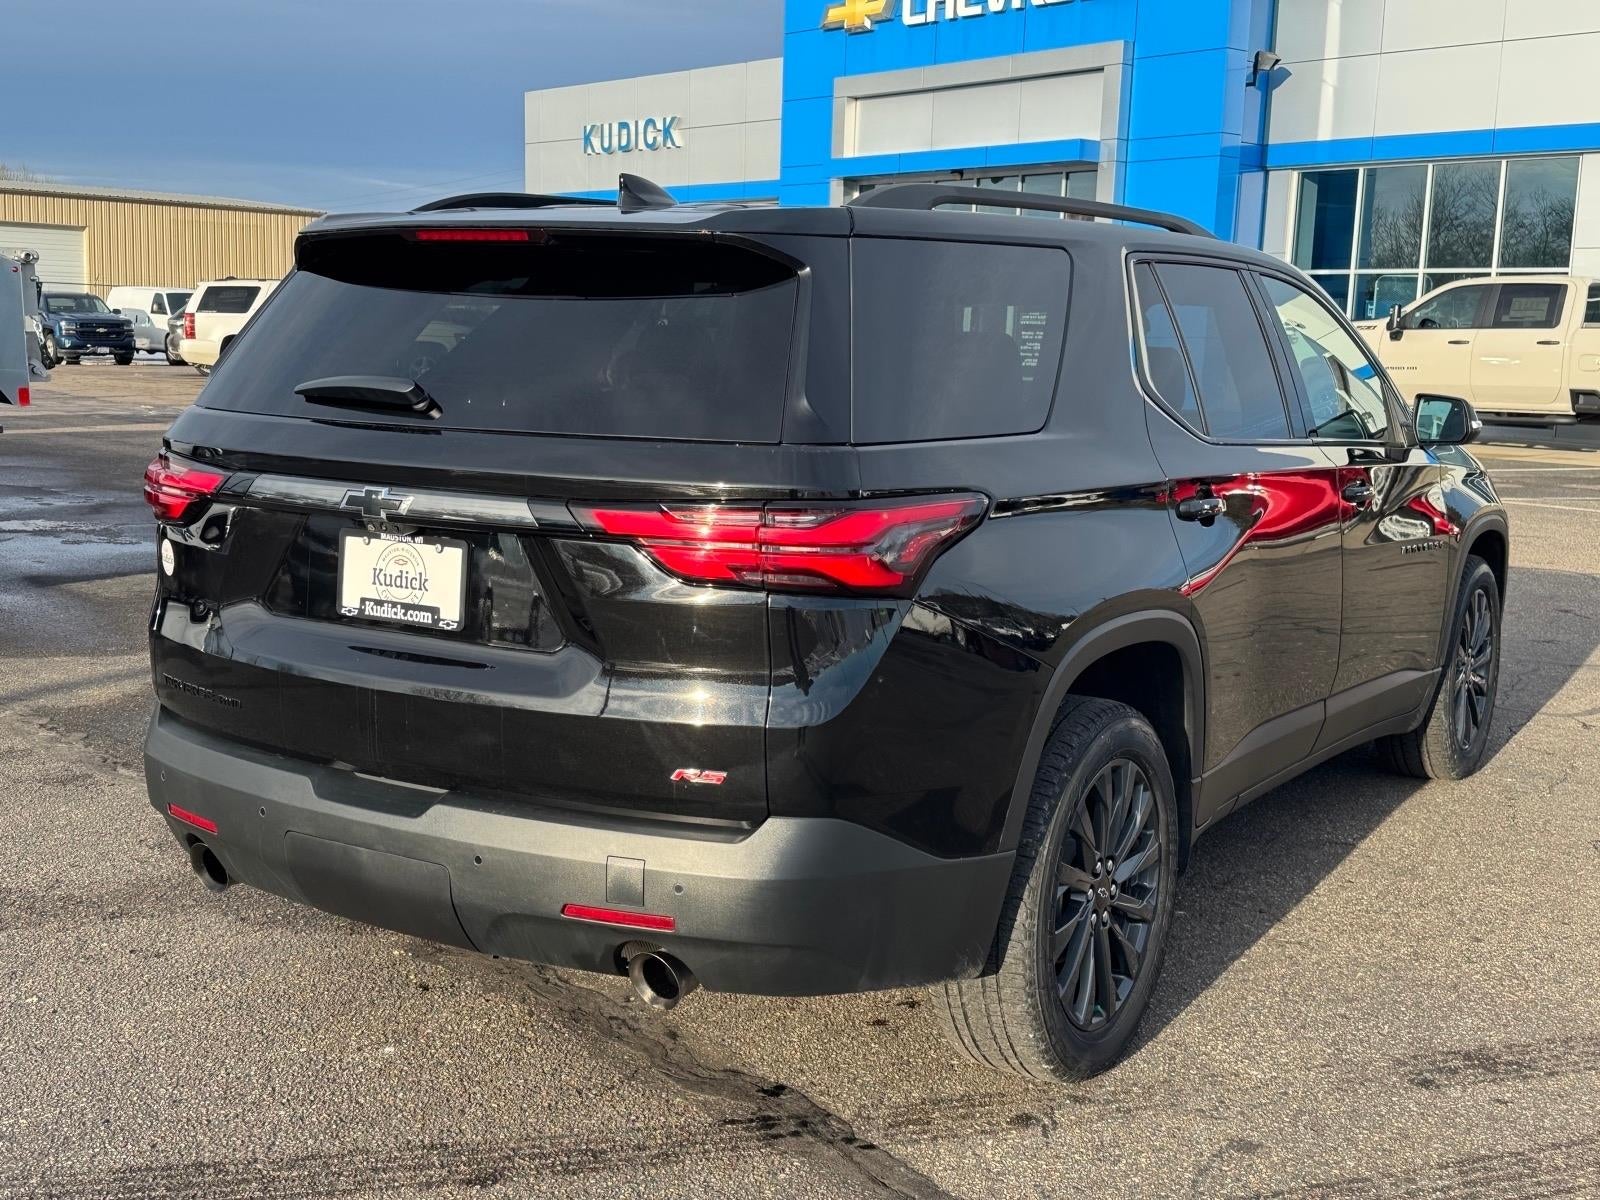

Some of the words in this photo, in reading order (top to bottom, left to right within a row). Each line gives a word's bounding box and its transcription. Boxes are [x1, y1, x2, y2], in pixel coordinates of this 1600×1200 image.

[583, 116, 682, 155] KUDICK
[372, 567, 429, 592] Kudick
[364, 601, 432, 624] Kudick.com
[669, 768, 728, 785] RS
